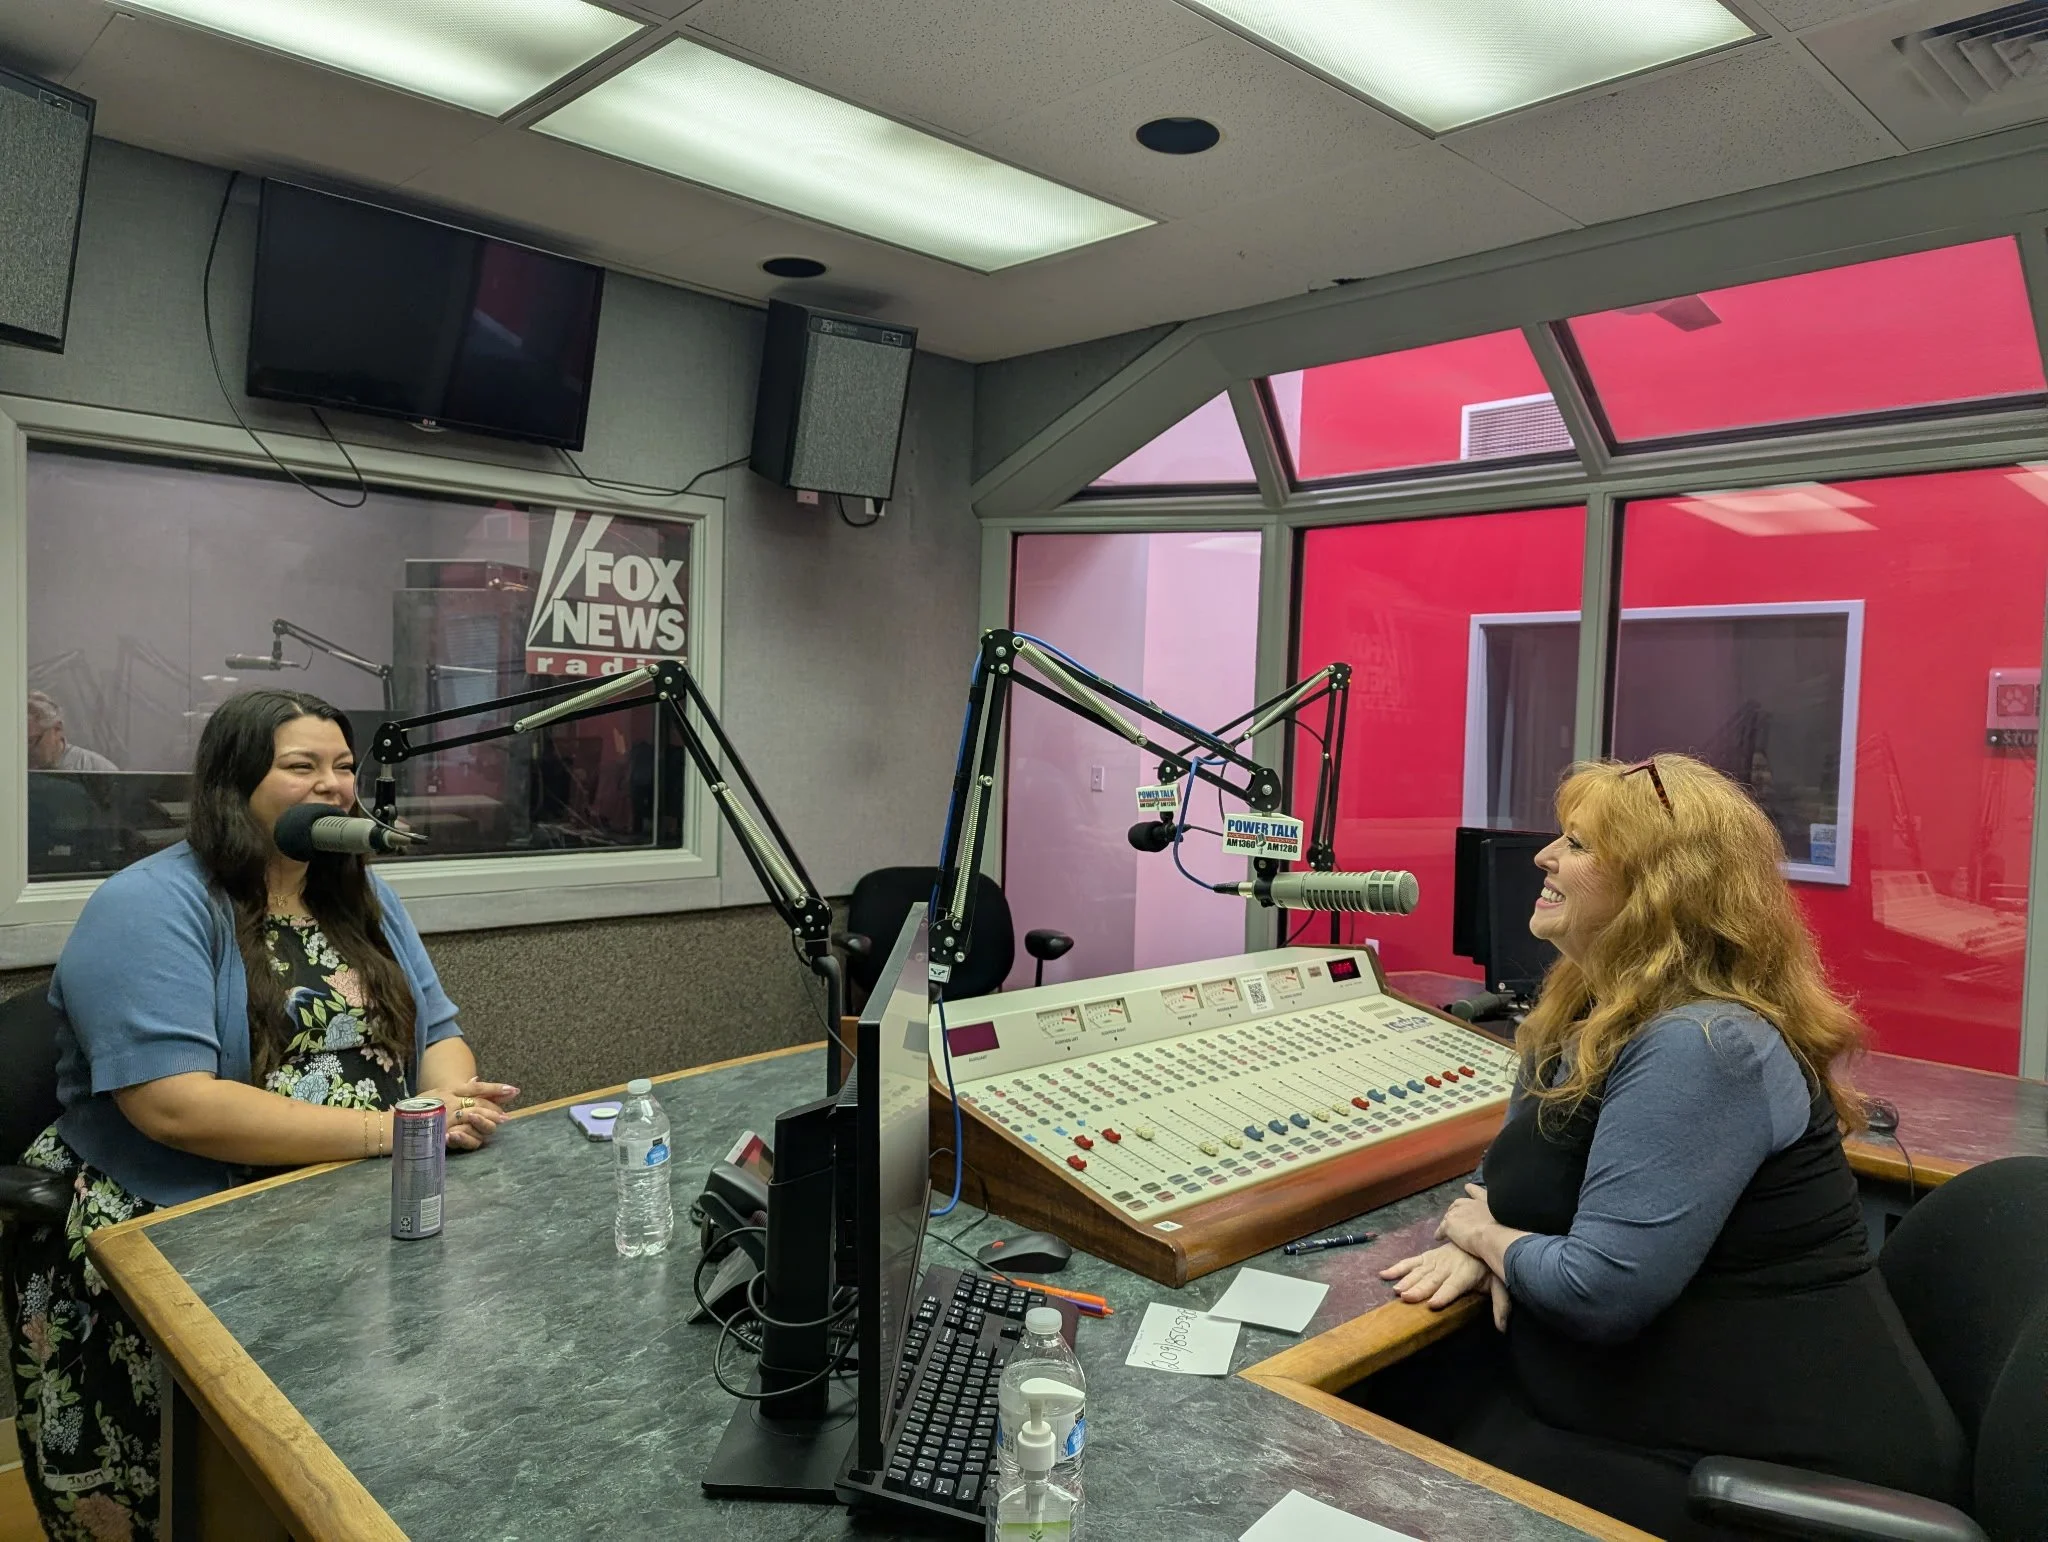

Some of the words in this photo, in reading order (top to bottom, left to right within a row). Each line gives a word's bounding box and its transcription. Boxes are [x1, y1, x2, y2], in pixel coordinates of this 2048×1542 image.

[585, 550, 684, 604] FOX
[552, 600, 685, 651] NEWS
[537, 657, 646, 675] radi
[1138, 790, 1159, 799] POWER
[1160, 789, 1174, 798] TALK
[1227, 819, 1269, 836] POWER
[1270, 823, 1298, 839] TALK
